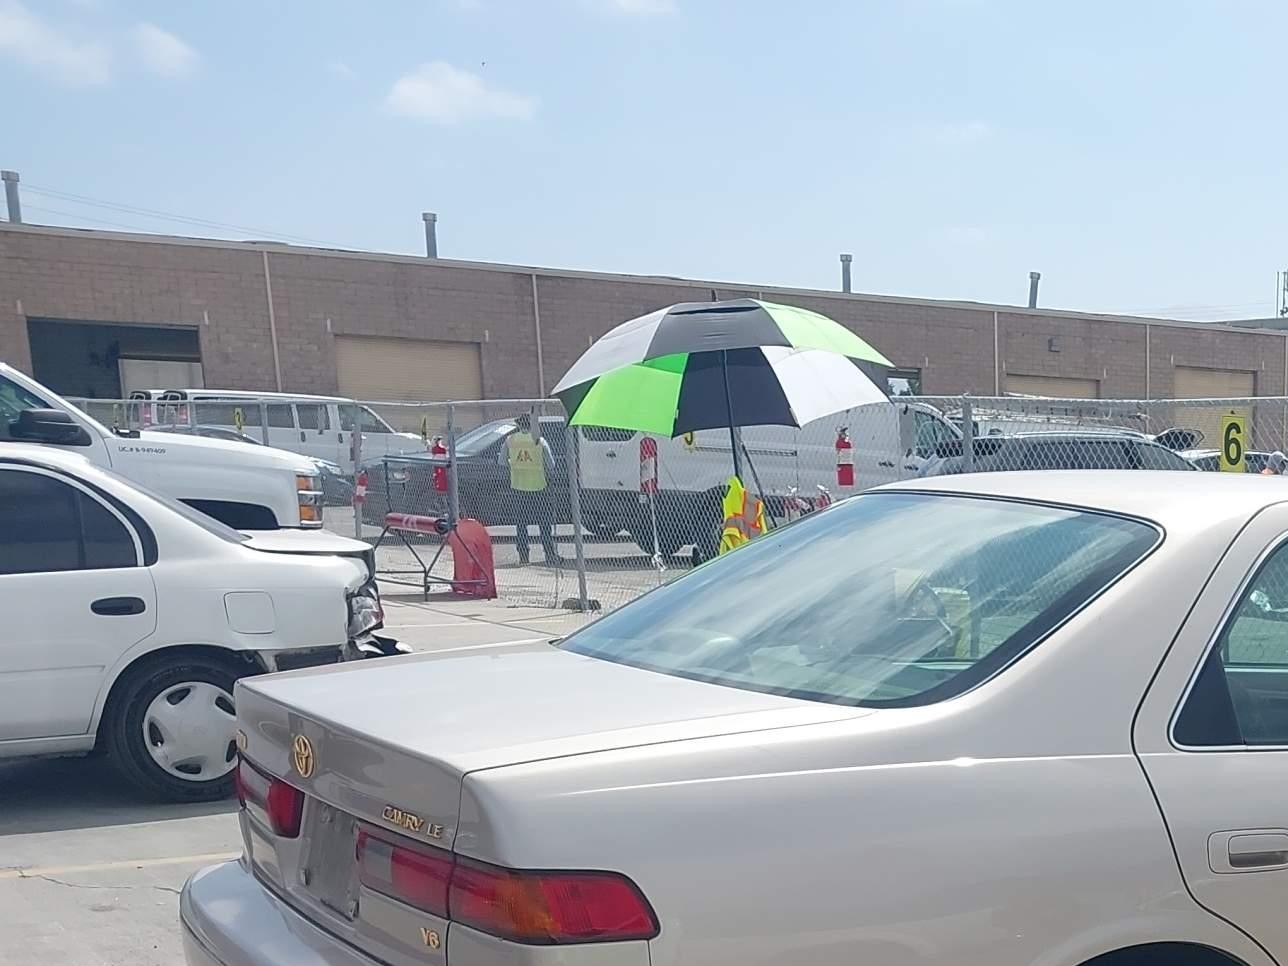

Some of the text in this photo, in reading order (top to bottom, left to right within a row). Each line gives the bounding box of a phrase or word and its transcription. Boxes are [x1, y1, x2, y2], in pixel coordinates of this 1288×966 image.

[1224, 422, 1242, 466] 6
[382, 805, 444, 839] CAMRY LE
[420, 927, 441, 949] V6
